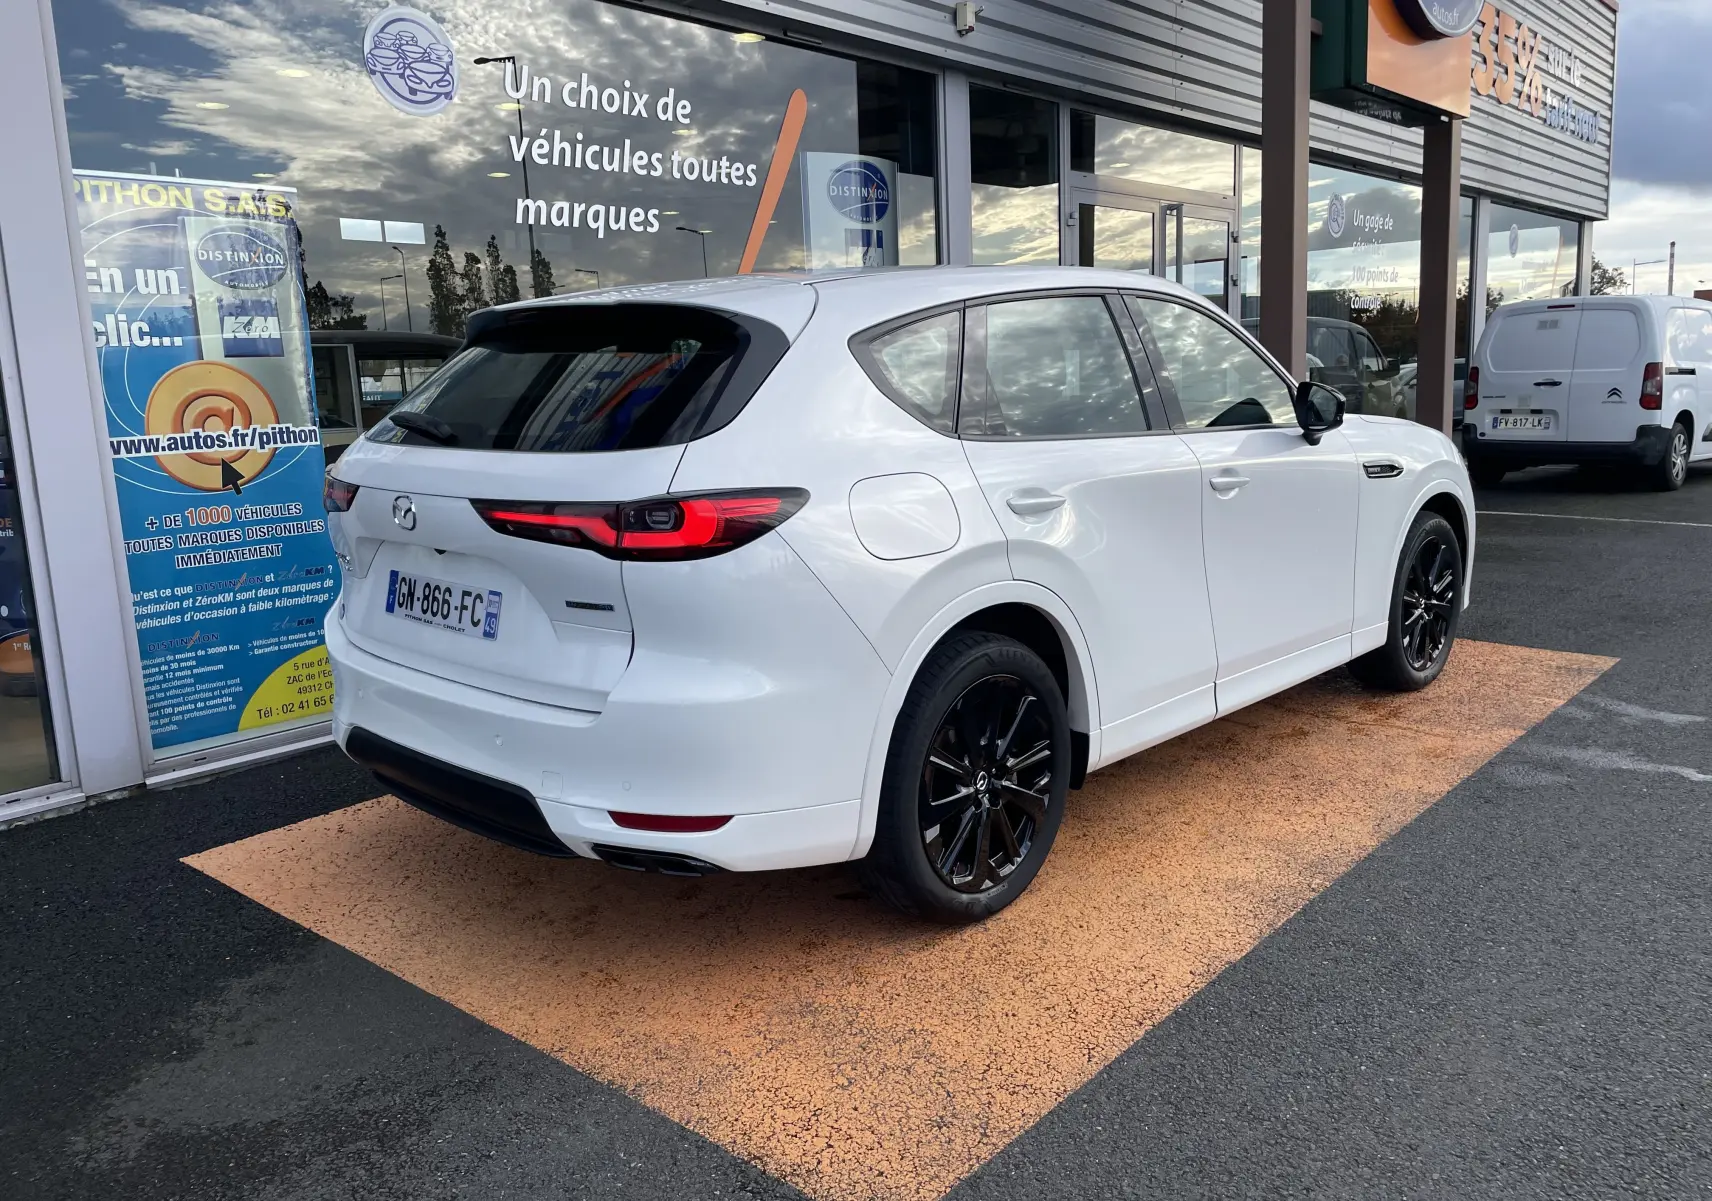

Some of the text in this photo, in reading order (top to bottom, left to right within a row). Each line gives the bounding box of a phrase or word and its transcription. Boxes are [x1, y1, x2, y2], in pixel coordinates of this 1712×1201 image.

[1433, 2, 1459, 25] autos.fr
[1473, 2, 1543, 117] 35%
[504, 61, 692, 124] Un choix de
[509, 128, 757, 187] véhicules toutes
[830, 183, 888, 201] DISTINXION
[203, 189, 294, 219] S.A.S.
[516, 198, 660, 238] marques
[1353, 209, 1394, 233] Un gage de
[198, 247, 284, 265] DISTINXION
[135, 267, 180, 295] un
[1366, 266, 1389, 286] points
[1390, 267, 1399, 283] de
[92, 313, 183, 348] clic...
[1498, 417, 1544, 428] FV-817-LK
[109, 426, 318, 455] www.autos.fr/pithon
[164, 515, 182, 529] DE
[185, 505, 231, 526] 1000
[236, 503, 302, 521] VÉHICULES
[125, 520, 325, 554] TOUTES MARQUES DISPONIBLES
[175, 543, 282, 569] IMMÉDIATEMENT
[133, 578, 334, 616] Distinxion et ZéroKM sont deux marques de
[160, 587, 172, 597] ce
[174, 585, 193, 600] que
[265, 574, 274, 583] et
[136, 613, 182, 630] véhicules
[184, 606, 238, 622] d'occasion
[240, 603, 246, 614] à
[248, 599, 273, 612] faible
[275, 594, 329, 609] kilomètrage
[397, 577, 484, 628] GN-866-FC
[288, 632, 307, 640] moins
[443, 623, 466, 633] CHOLET
[484, 615, 496, 634] 49
[175, 651, 195, 660] moins
[207, 646, 228, 655] 30000
[254, 639, 318, 655] Garantie constructeur
[175, 669, 191, 677] mois
[193, 664, 224, 674] minimum
[180, 660, 196, 668] mois
[293, 663, 299, 671] 5
[301, 660, 315, 669] rue
[161, 677, 195, 689] accidentés
[166, 686, 195, 697] véhicules
[196, 680, 226, 691] Distinxion
[227, 677, 240, 685] sont
[287, 674, 304, 685] ZAC
[306, 672, 316, 681] de
[297, 683, 323, 695] 49312
[161, 707, 173, 715] 100
[174, 704, 195, 714] points
[206, 696, 233, 707] contrôle
[257, 707, 273, 720] Tél
[282, 702, 295, 714] 02
[298, 700, 310, 711] 41
[313, 696, 327, 708] 65
